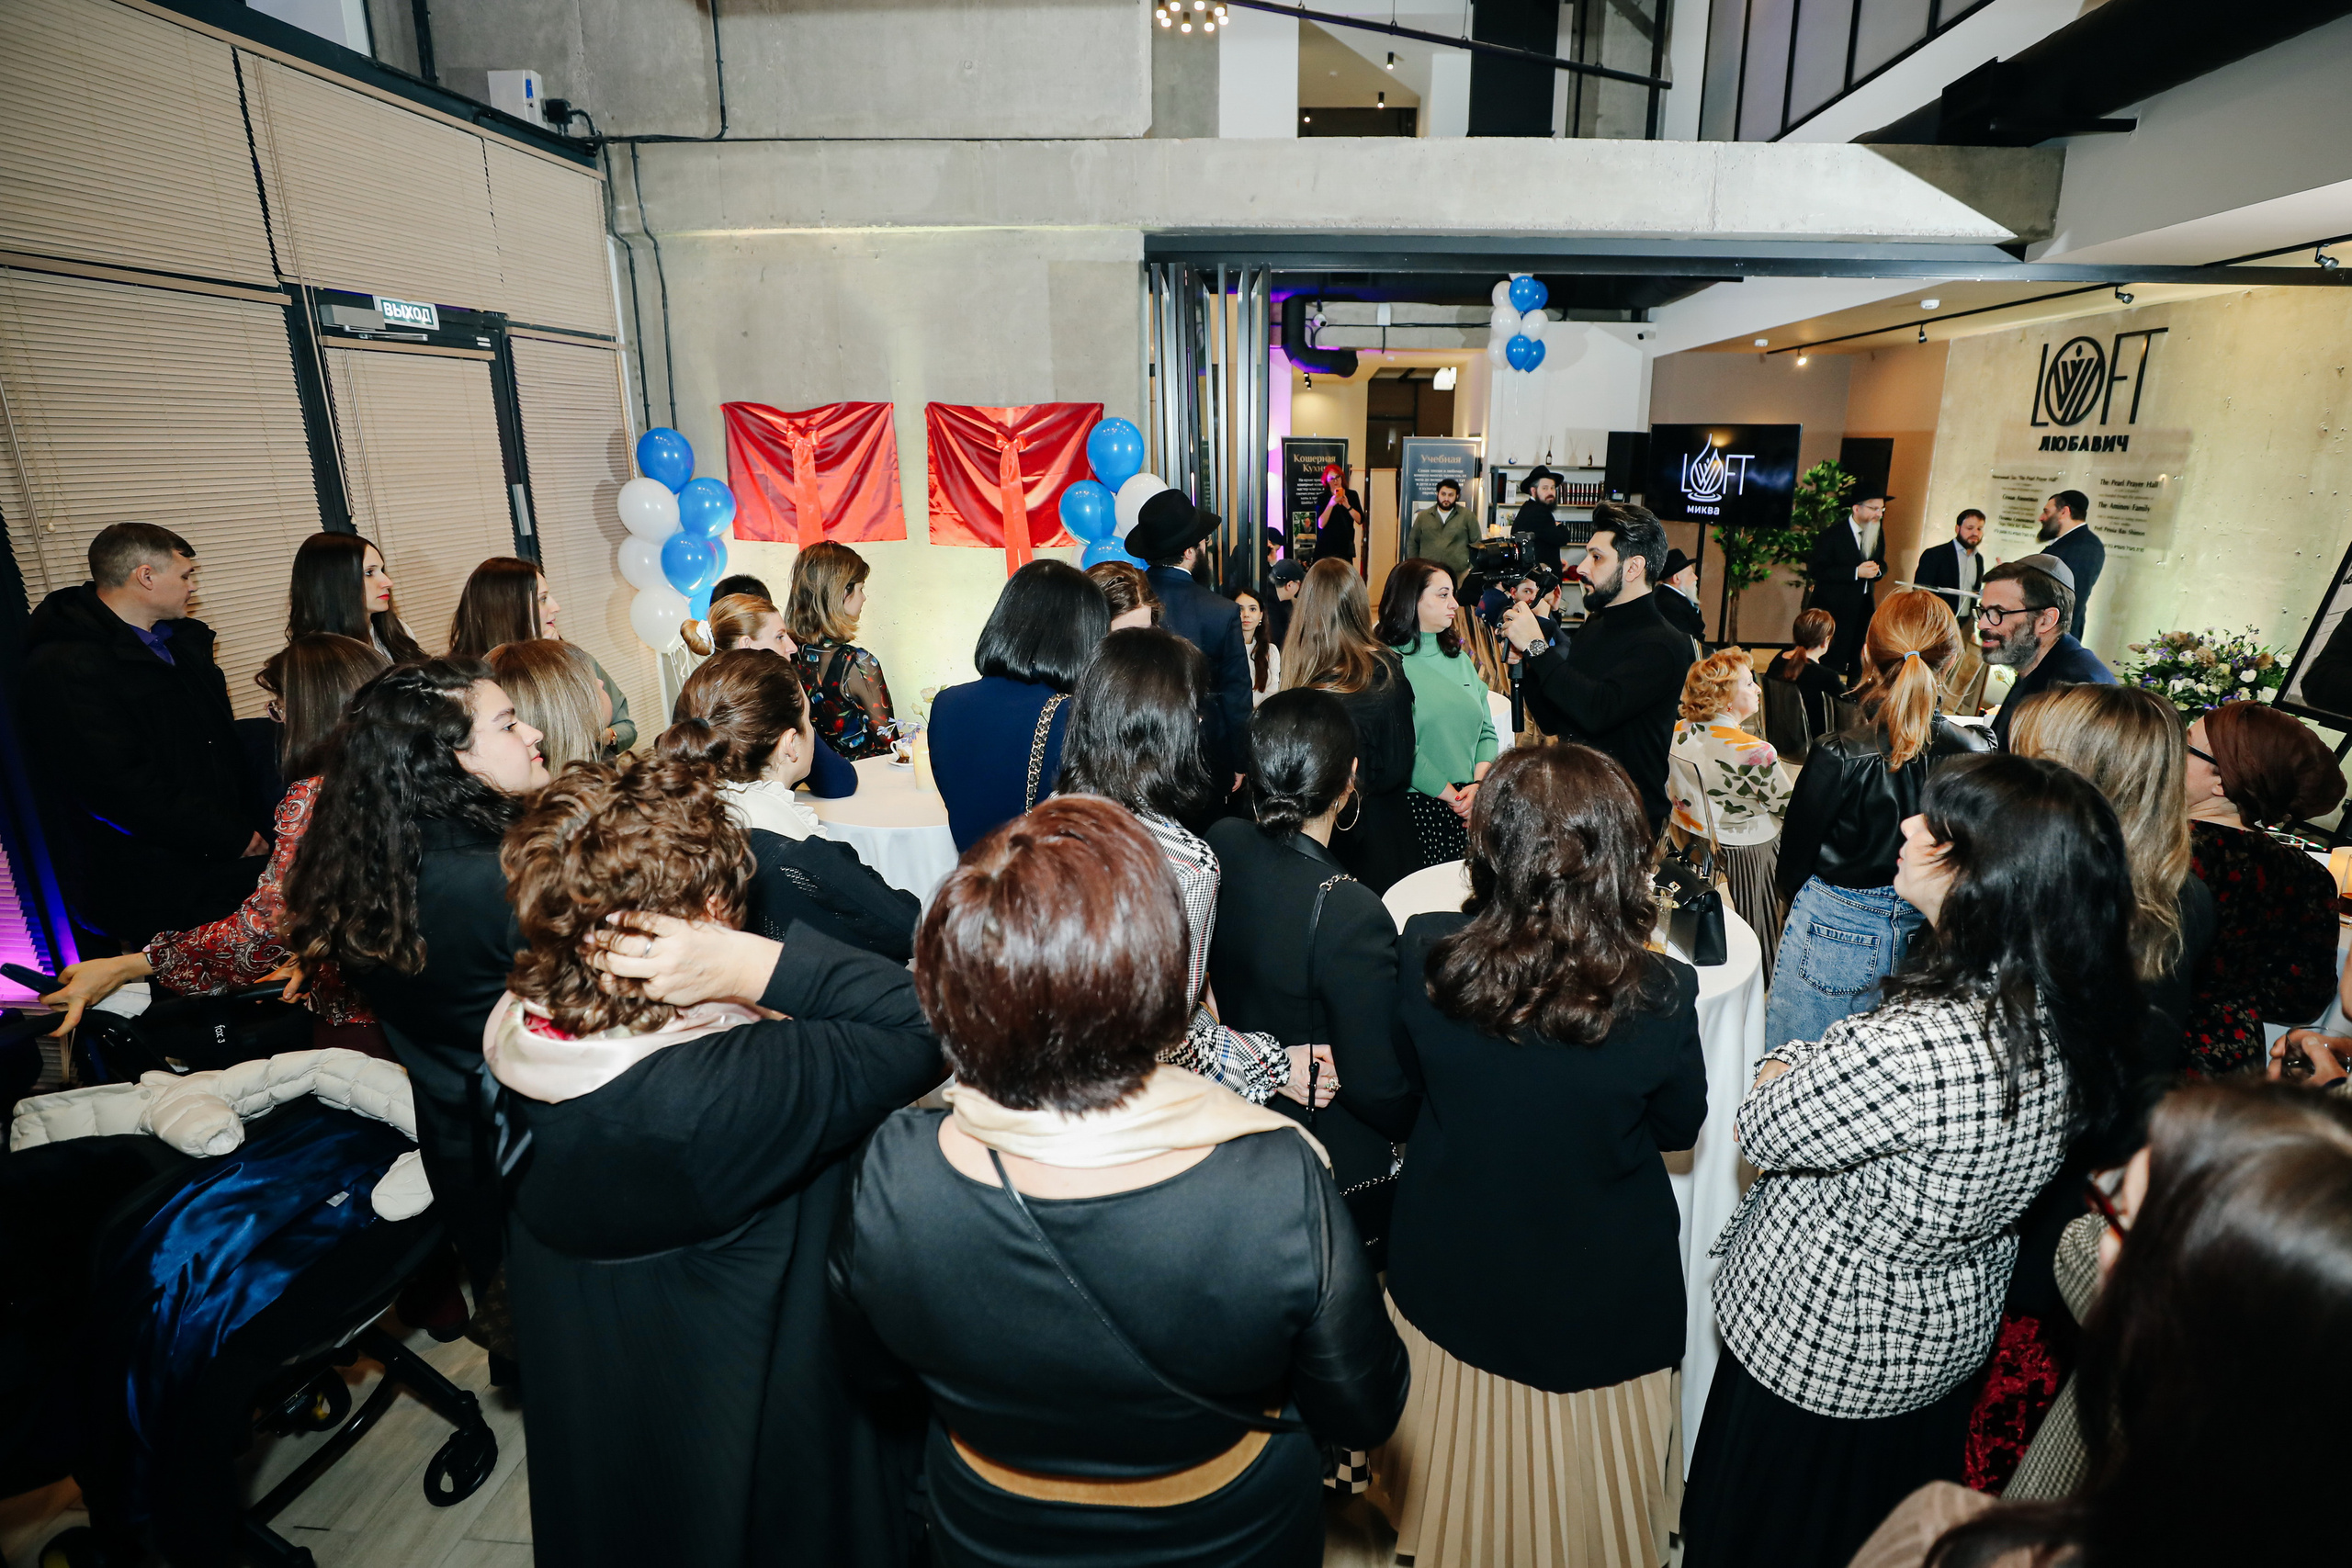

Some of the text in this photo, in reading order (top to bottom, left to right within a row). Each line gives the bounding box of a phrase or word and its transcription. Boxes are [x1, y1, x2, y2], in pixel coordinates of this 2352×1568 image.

[383, 302, 432, 322] ВЫХОД
[2030, 327, 2168, 426] LOFT
[2038, 434, 2130, 452] ЛЮБАВИЧ
[1293, 454, 1336, 464] Кошерная
[1420, 454, 1462, 464] Учебная
[1680, 434, 1755, 497] LOFT
[2126, 480, 2143, 489] Prayer
[2132, 503, 2151, 513] Family
[214, 1024, 226, 1038] fox
